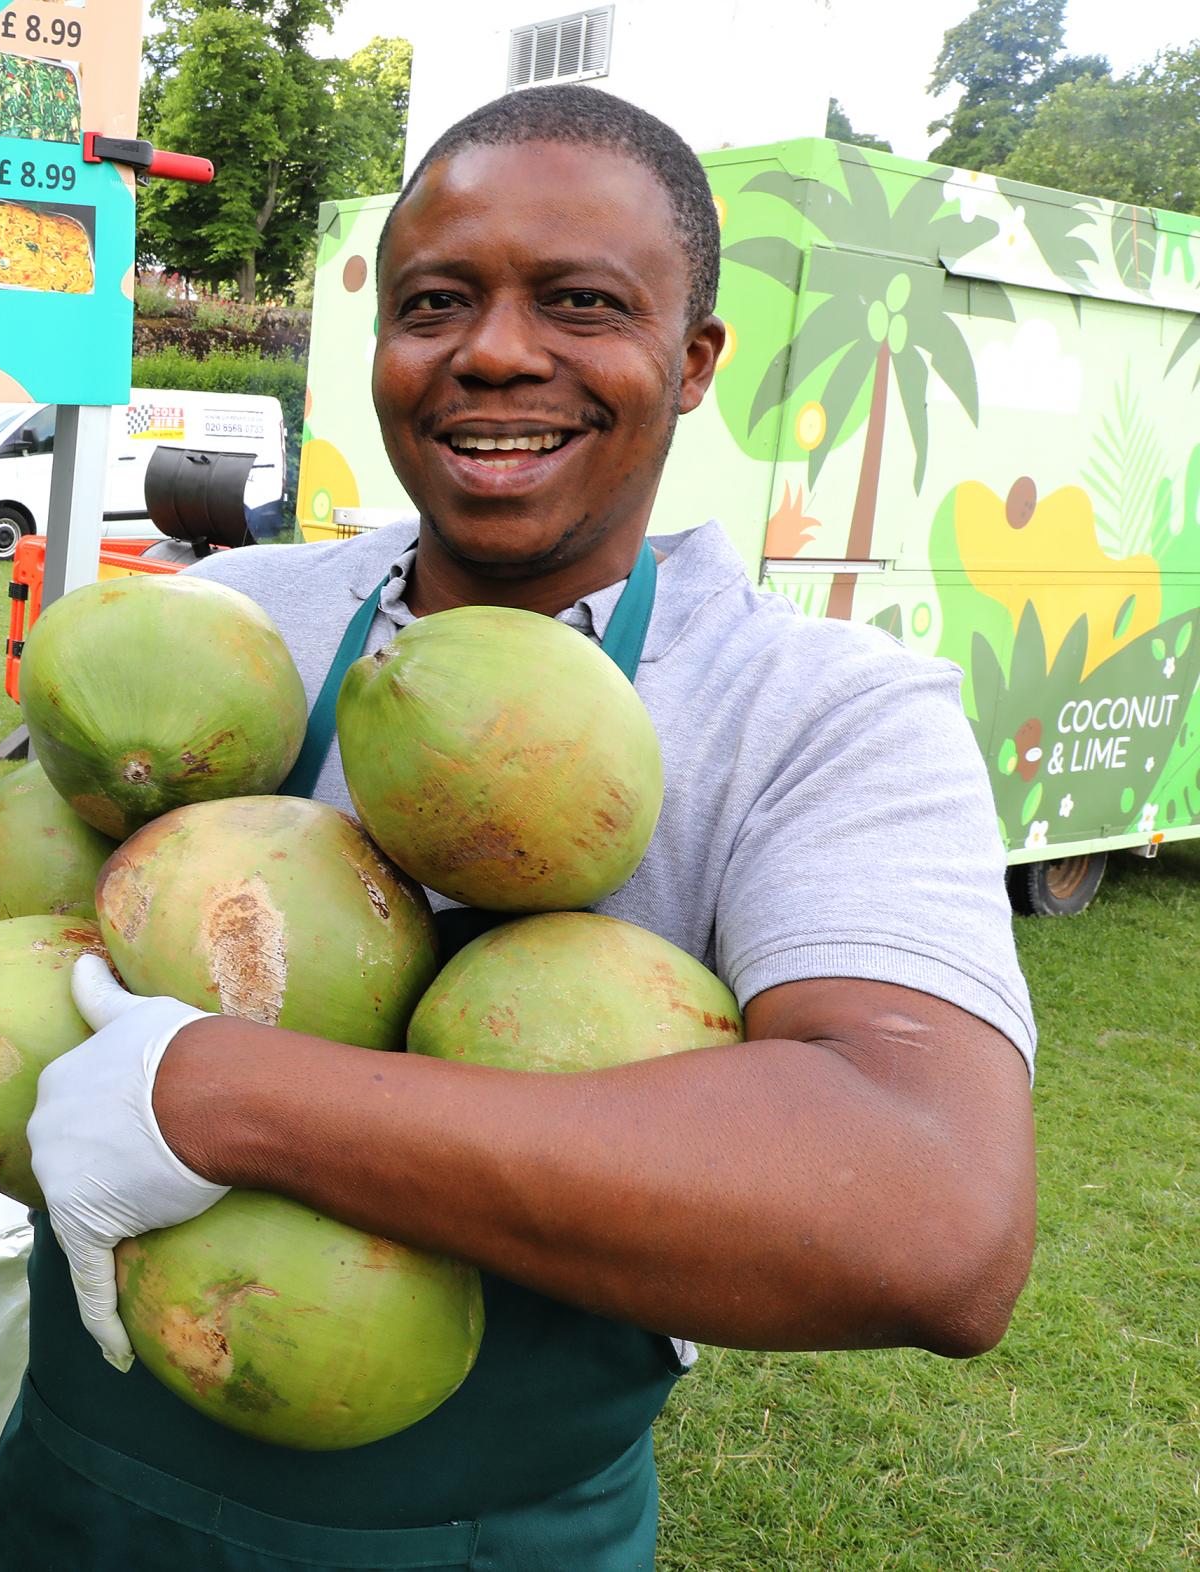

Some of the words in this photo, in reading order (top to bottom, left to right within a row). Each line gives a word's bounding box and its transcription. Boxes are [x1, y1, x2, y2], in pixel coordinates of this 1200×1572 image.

[1, 11, 16, 39] £
[25, 15, 82, 47] 8.99
[20, 161, 76, 191] 8.99
[1057, 695, 1179, 733] COCONUT
[1048, 742, 1064, 775] &
[1070, 736, 1131, 772] LIME
